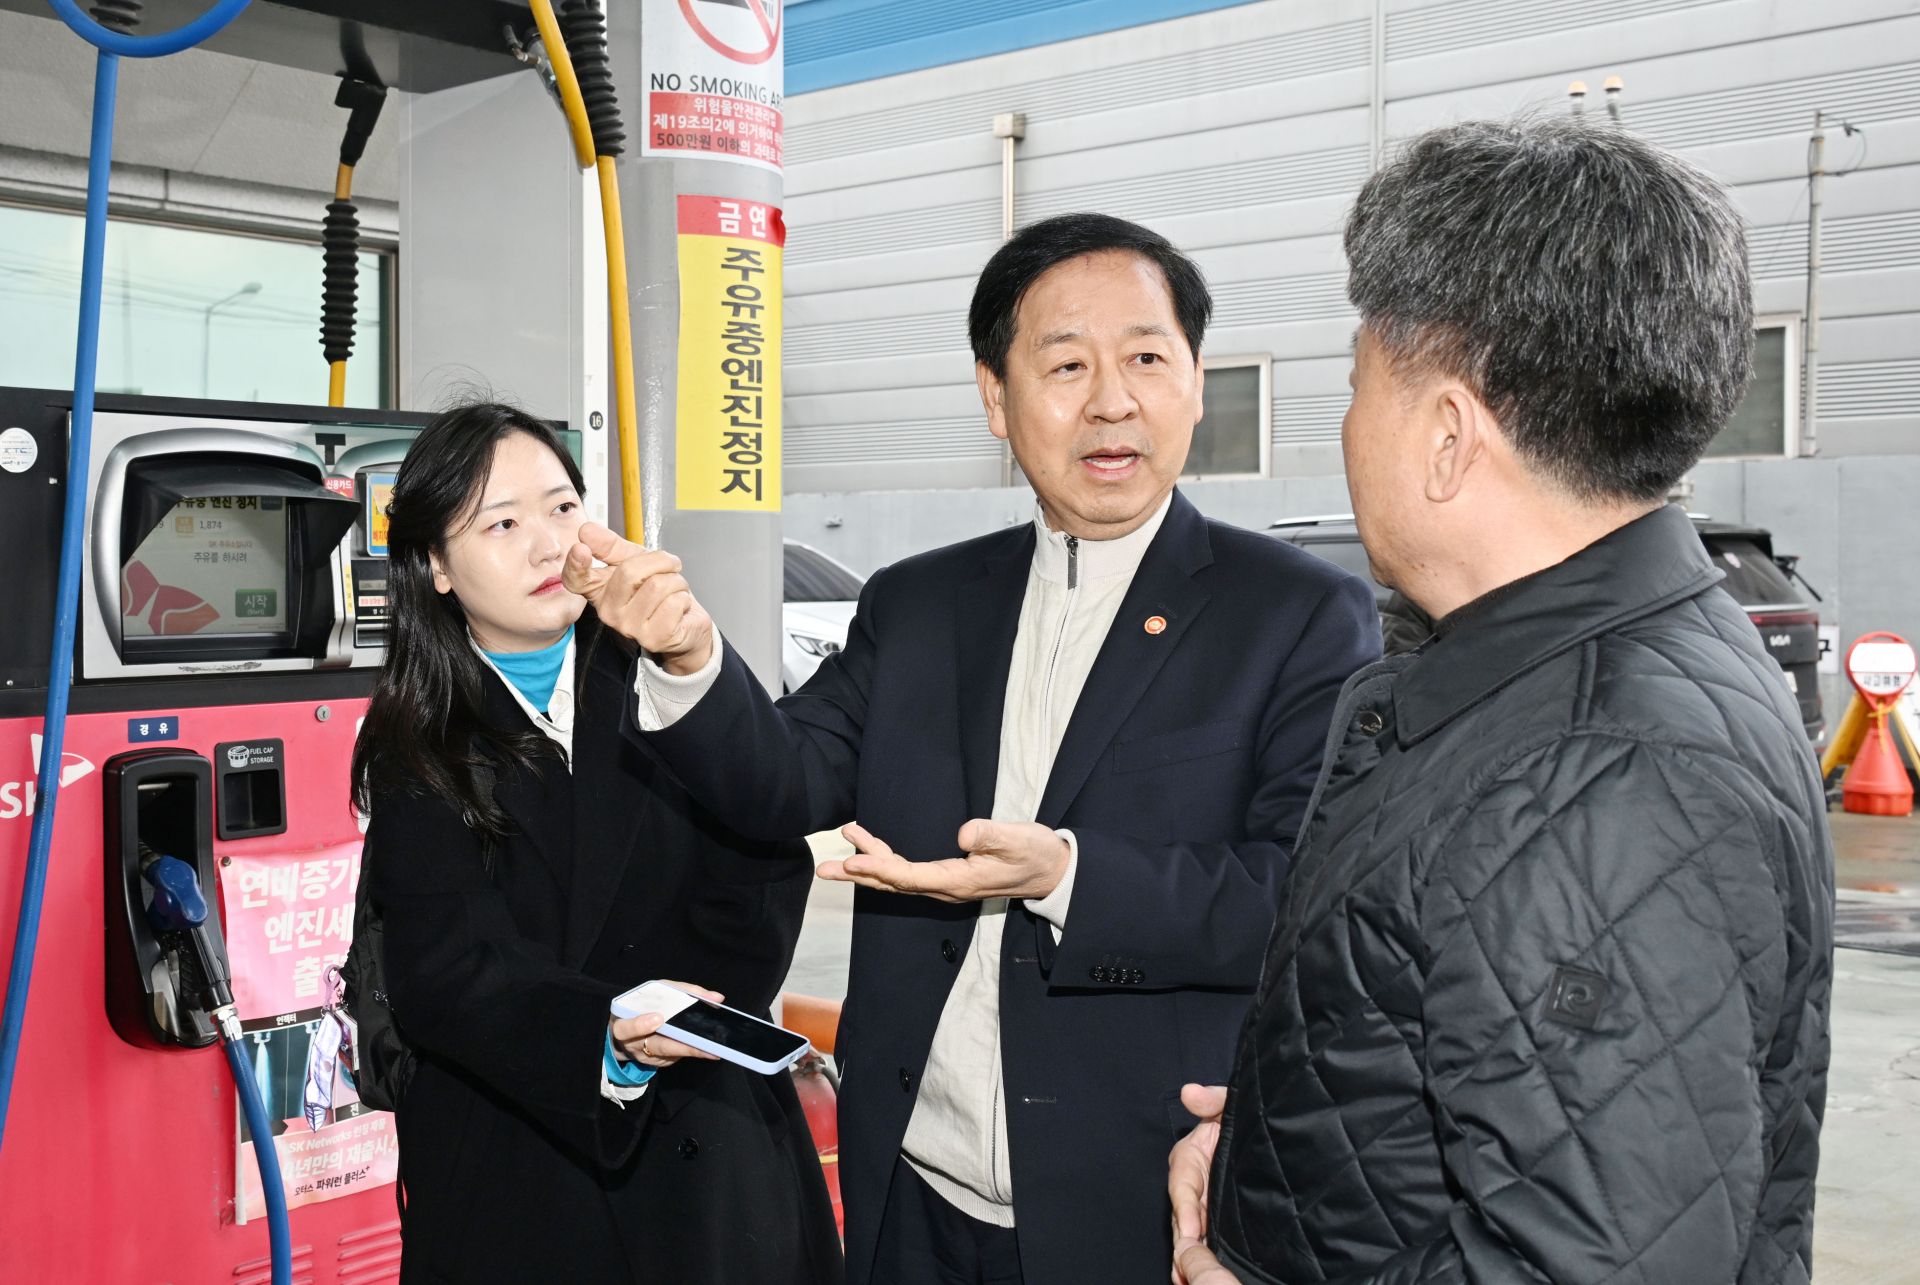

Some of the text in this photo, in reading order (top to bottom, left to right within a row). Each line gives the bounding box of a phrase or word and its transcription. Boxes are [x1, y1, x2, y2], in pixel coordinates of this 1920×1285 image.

[651, 73, 783, 108] NO SMOKING AR
[653, 113, 735, 136] 제19조의2에
[656, 133, 711, 150] 500만원
[717, 136, 751, 156] 이하의
[718, 202, 767, 238] 금연
[720, 247, 765, 501] 주유중엔진정지
[592, 415, 602, 428] 16
[326, 480, 353, 490] 신용카드
[200, 521, 222, 530] 1,874
[194, 552, 219, 563] 주유를
[244, 594, 268, 609] 시작
[250, 756, 274, 765] STORAGE
[293, 949, 350, 999] 출
[288, 1140, 305, 1153] SK
[306, 1128, 352, 1151] Networks
[295, 1184, 314, 1196] 오터스
[316, 1175, 342, 1191] 파워런
